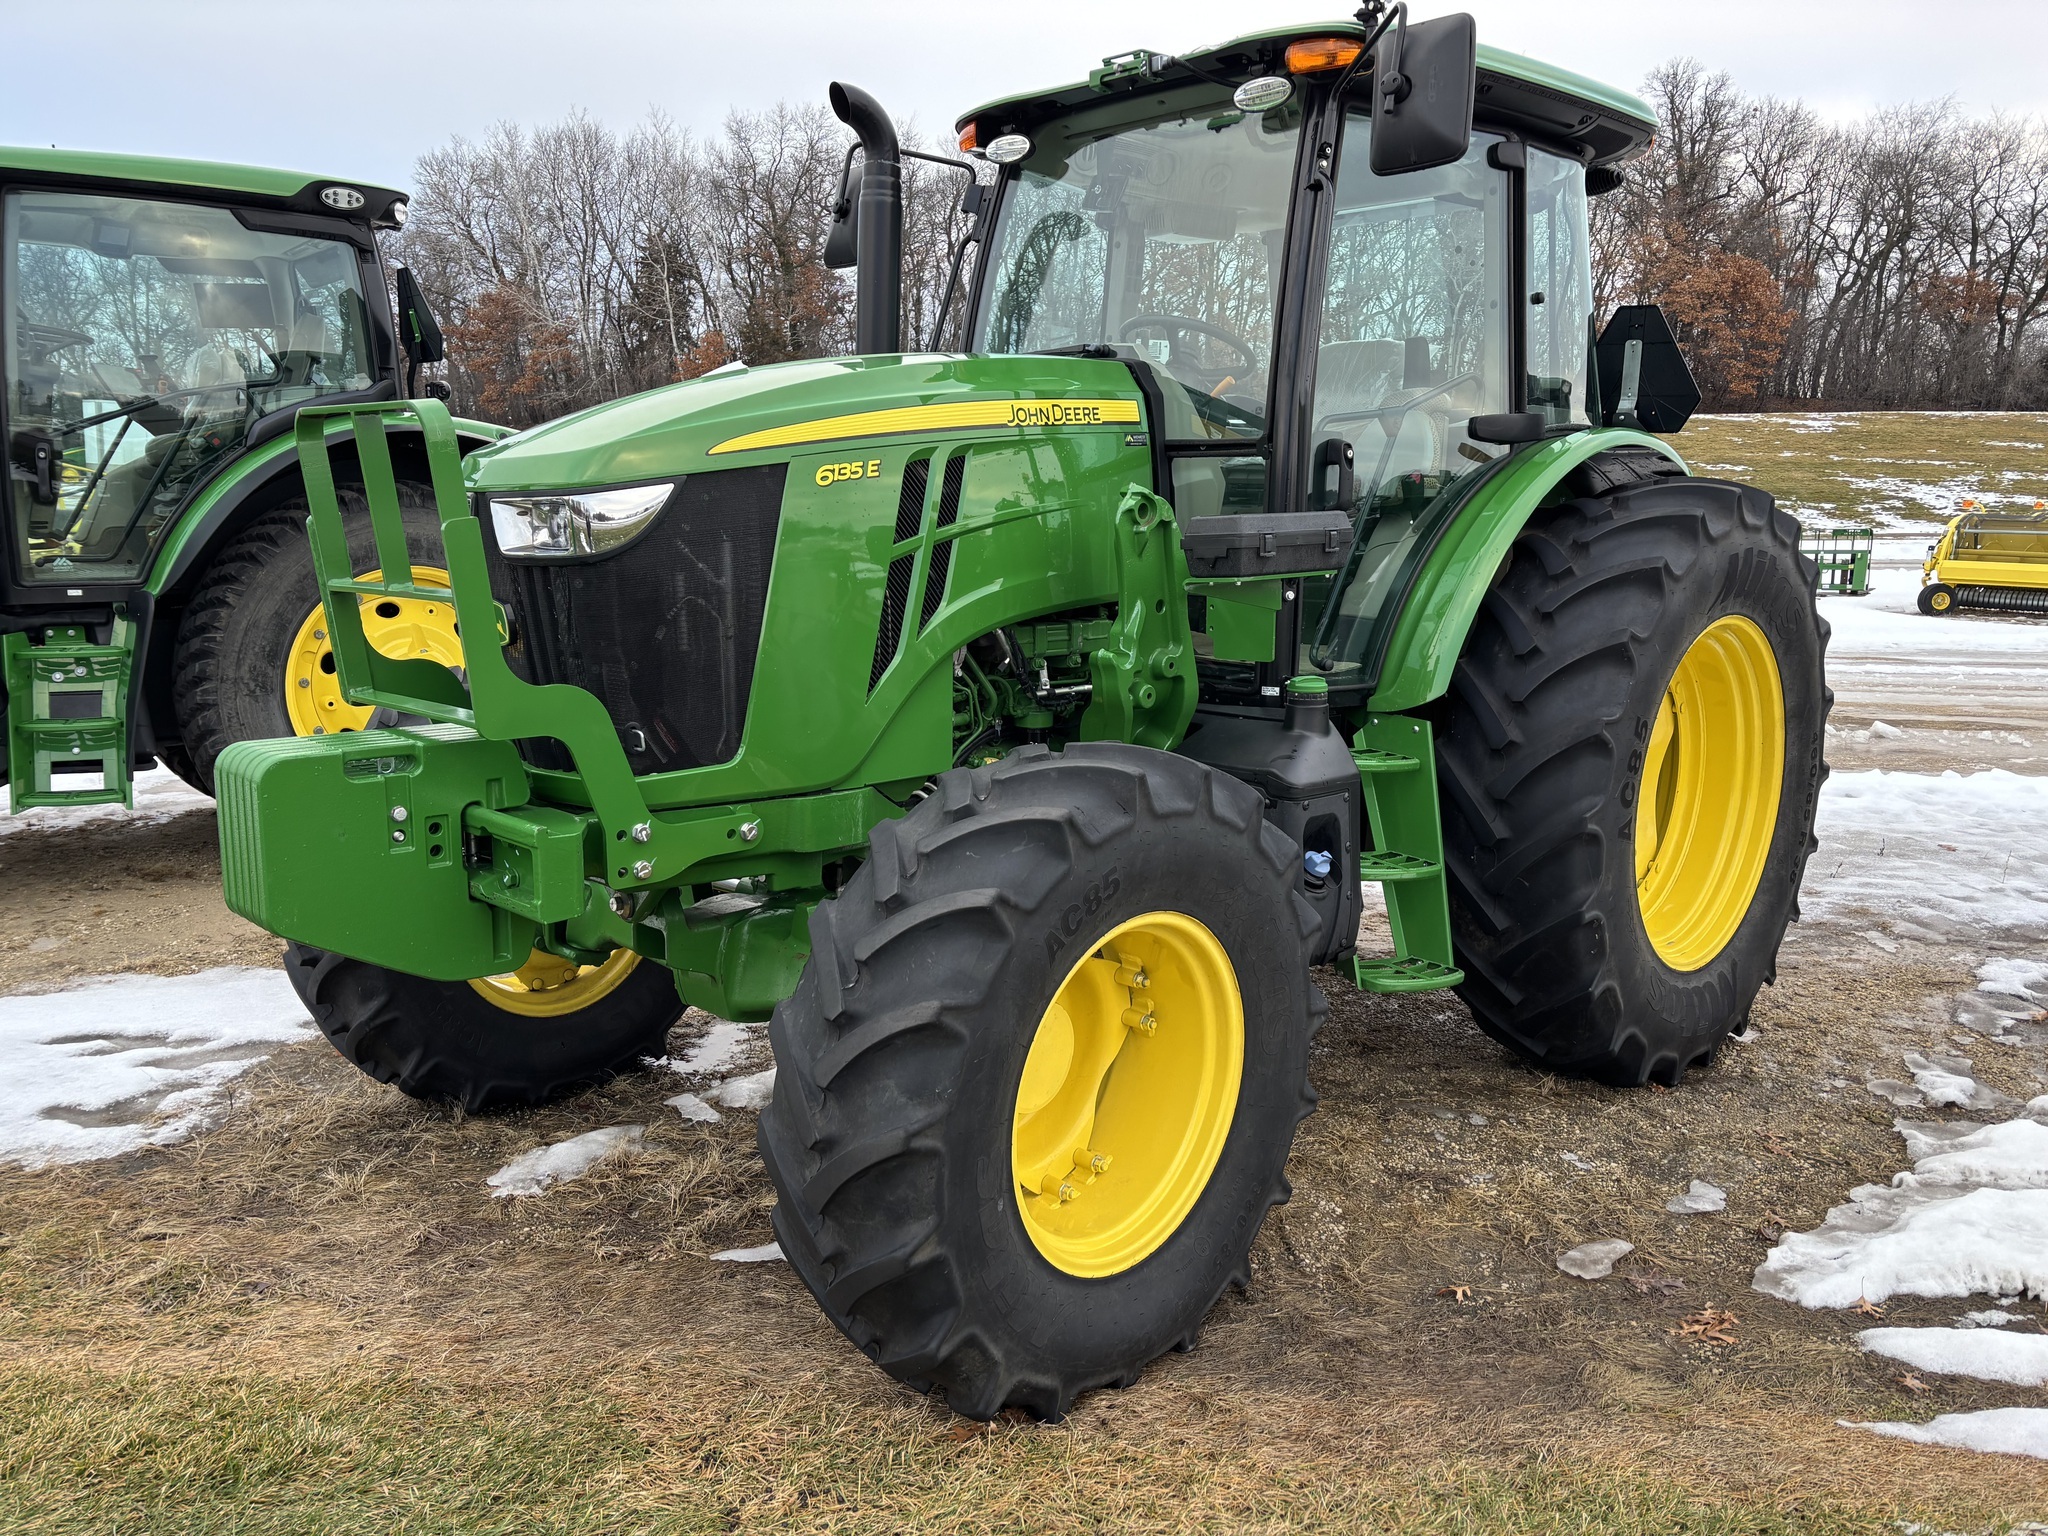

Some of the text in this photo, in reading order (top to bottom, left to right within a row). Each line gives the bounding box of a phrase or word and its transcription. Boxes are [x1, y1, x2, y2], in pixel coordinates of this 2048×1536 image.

[1006, 403, 1102, 425] JOHN DEERE
[814, 458, 882, 488] 6135 E
[1618, 716, 1649, 841] AC85
[1044, 865, 1121, 969] AC85
